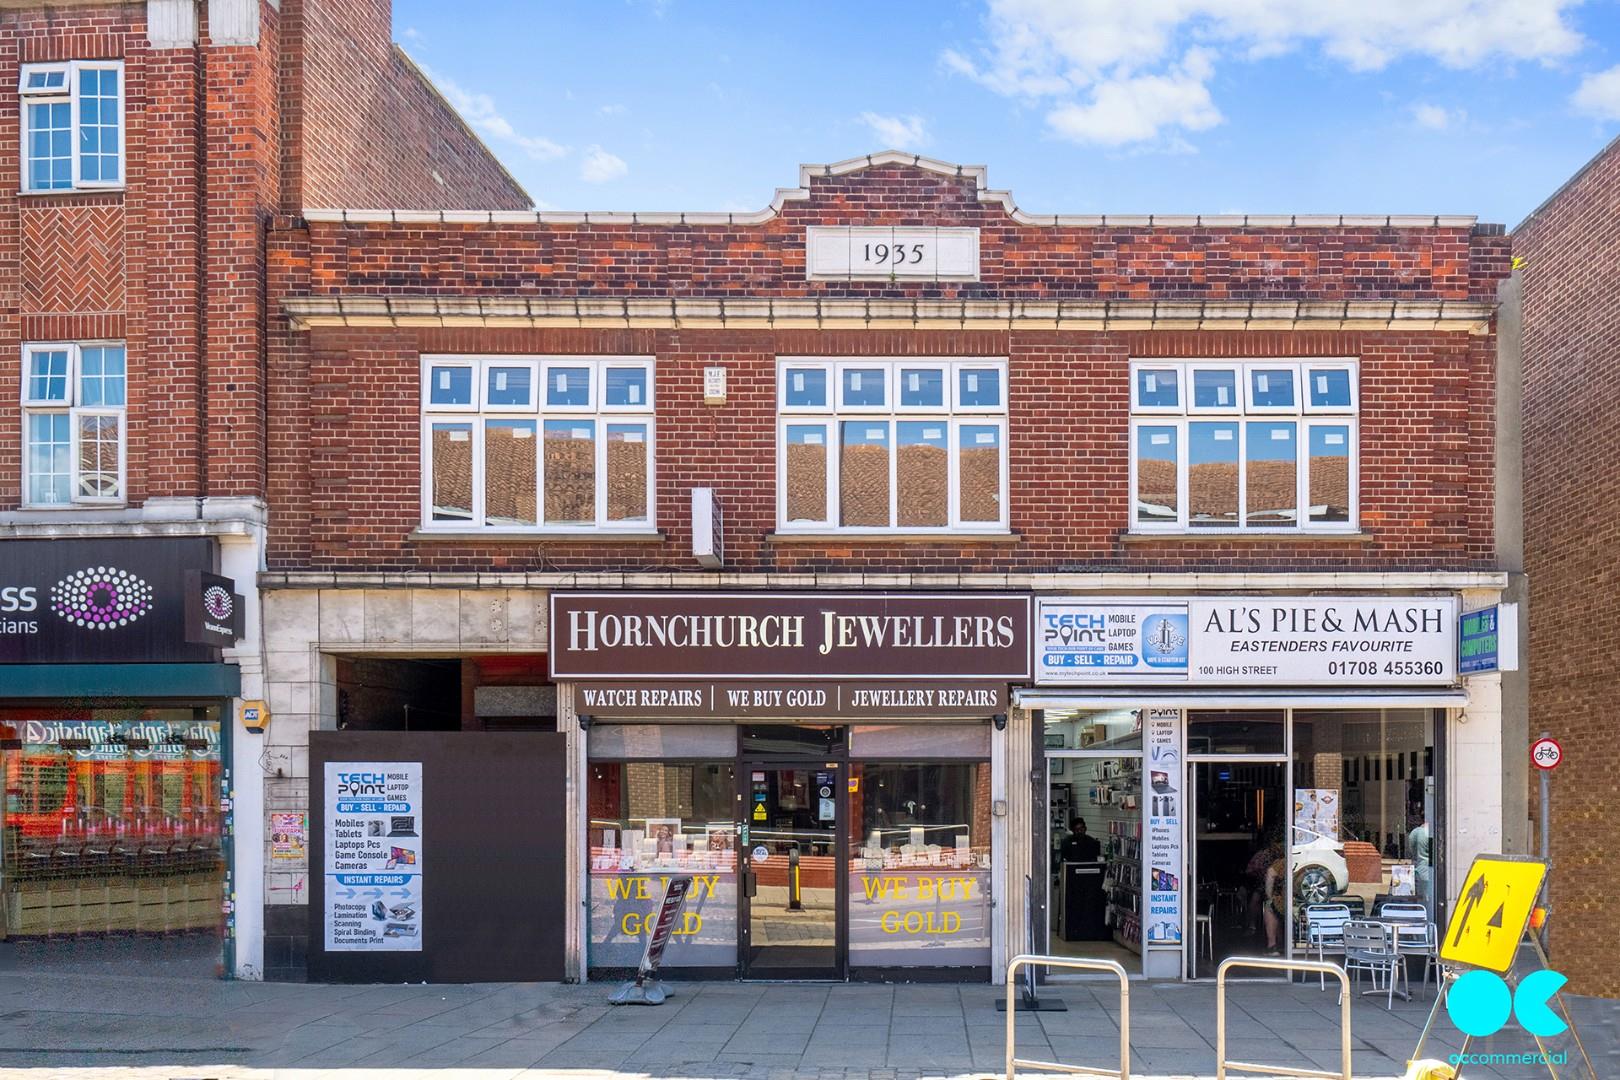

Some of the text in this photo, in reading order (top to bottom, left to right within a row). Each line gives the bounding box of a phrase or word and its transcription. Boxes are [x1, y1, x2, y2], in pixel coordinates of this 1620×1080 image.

[864, 243, 925, 265] 1935
[1044, 614, 1105, 629] TECH
[1108, 614, 1136, 623] MOBILE
[1352, 607, 1443, 633] MASH
[1108, 628, 1137, 637] LAPTOP
[1108, 642, 1134, 651] GAMES
[1230, 640, 1413, 652] EASTENDERS FAVOURITE
[1048, 655, 1064, 665] BUY
[1074, 655, 1094, 665] SELL
[1103, 655, 1133, 665] REPAIR
[1199, 666, 1278, 675] 100 HIGH STREET
[1328, 661, 1443, 676] 01708 455360
[583, 689, 702, 707] WATCH REPAIRS
[727, 689, 827, 707] WE BUY GOLD
[851, 689, 998, 707] JEWELLERY REPAIRS
[245, 710, 258, 719] ADT
[337, 773, 384, 784] TECH
[340, 803, 353, 811] BUY
[360, 803, 376, 811] SELL
[384, 803, 406, 811] REPAIR
[335, 819, 364, 827] Mobiles
[335, 829, 362, 838] Tablets
[335, 840, 381, 850] Laptops Pcs
[335, 851, 388, 859] Game Console
[335, 861, 368, 870] Cameras
[344, 875, 403, 884] INSTANT REPAIRS
[607, 876, 653, 900] WE
[861, 876, 977, 900] WE BUY
[1151, 894, 1177, 902] INSTANT
[1151, 906, 1178, 914] REPAIRS
[334, 920, 362, 928] Scanning
[880, 910, 961, 934] GOLD
[334, 928, 376, 936] Spiral Binding
